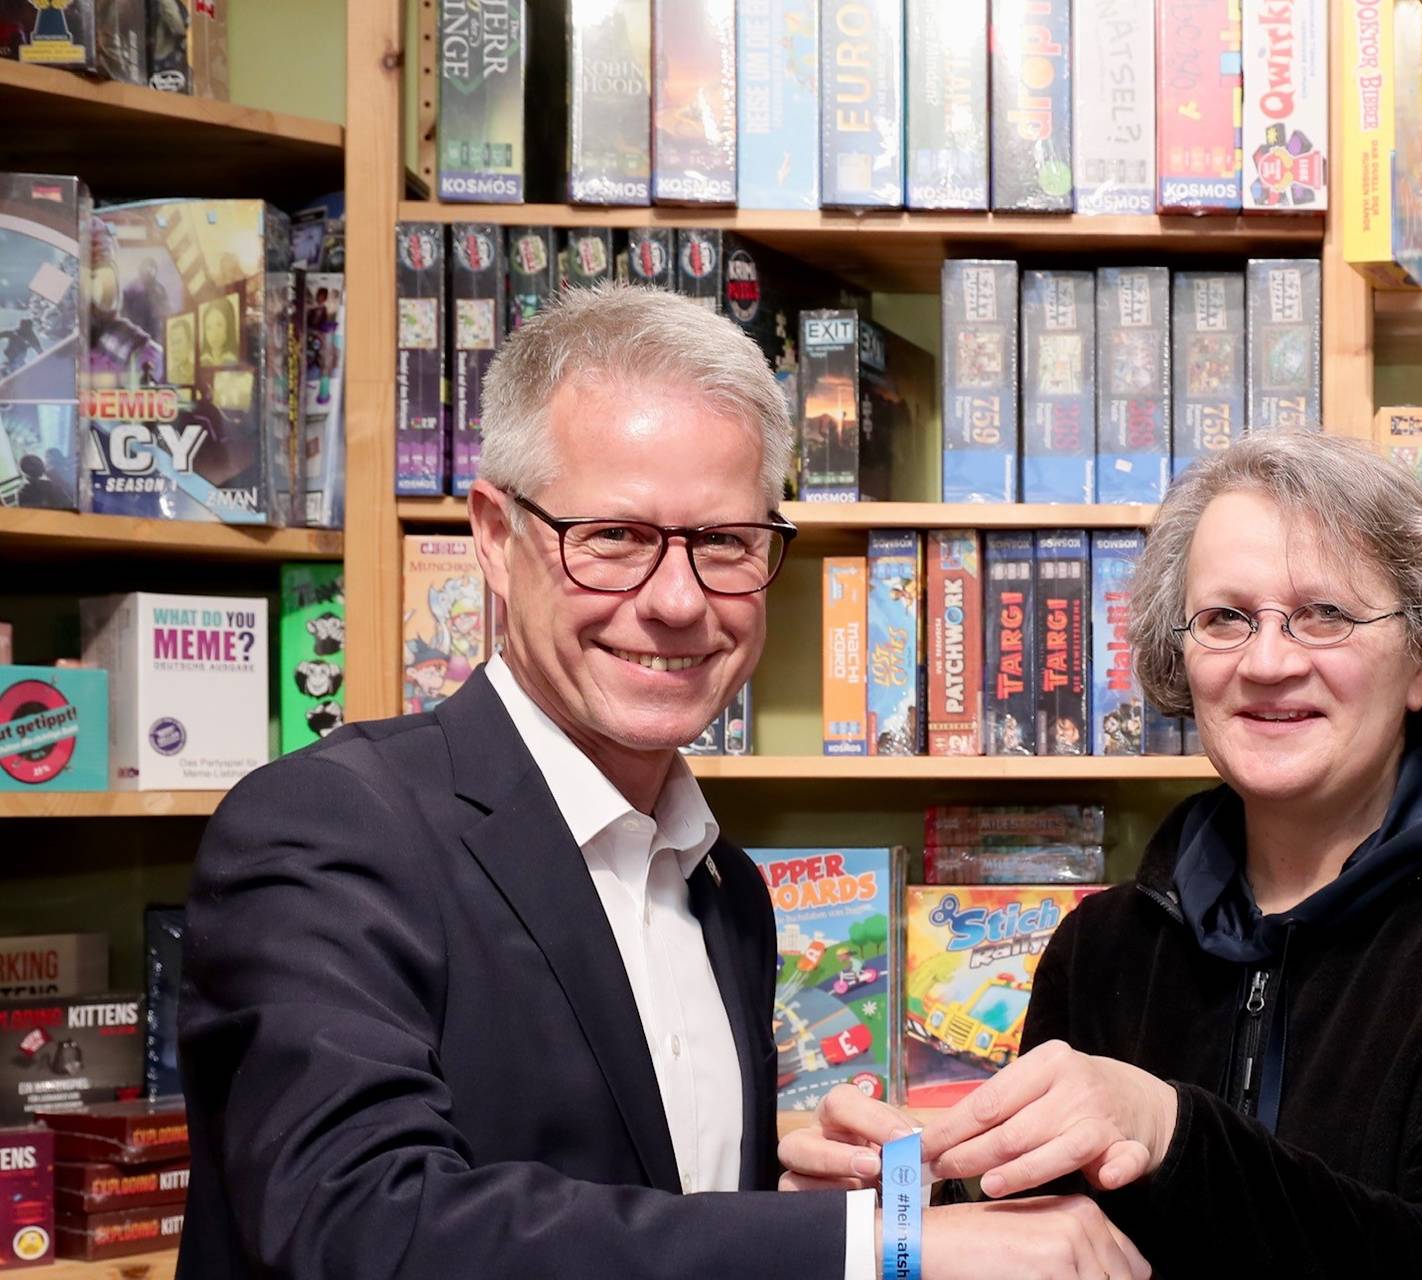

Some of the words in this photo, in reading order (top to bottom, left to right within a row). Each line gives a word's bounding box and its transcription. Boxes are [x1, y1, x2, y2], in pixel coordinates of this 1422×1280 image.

[581, 78, 643, 96] HOOD
[1008, 25, 1062, 140] drop
[1359, 74, 1383, 130] BIBBER
[441, 177, 518, 194] KOSMOS
[573, 180, 648, 198] KOSMOS
[657, 178, 732, 195] KOSMOS
[913, 186, 983, 201] KOSMOS
[1163, 181, 1237, 200] KOSMOS
[1079, 193, 1151, 211] KOSMOS
[808, 321, 851, 341] EXIT
[971, 396, 1000, 445] 759
[1128, 400, 1157, 448] 368
[1202, 403, 1231, 449] 759
[105, 477, 165, 493] SEASON
[806, 493, 855, 502] KOSMOS
[1097, 538, 1138, 549] KOSMOS
[409, 560, 478, 574] MUNCHKIN
[153, 608, 197, 627] WHAT
[202, 609, 223, 627] DO
[227, 611, 255, 629] YOU
[153, 628, 255, 662] MEME?
[944, 578, 964, 714] PATCHWORK
[997, 592, 1025, 700] TARGI
[1044, 599, 1069, 693] TARGI
[153, 662, 205, 671] DEUTSCHE
[16, 707, 77, 737] getippt!
[947, 898, 1061, 951] Stich
[68, 1003, 139, 1028] KITTENS
[92, 1173, 158, 1197] EXPLODING
